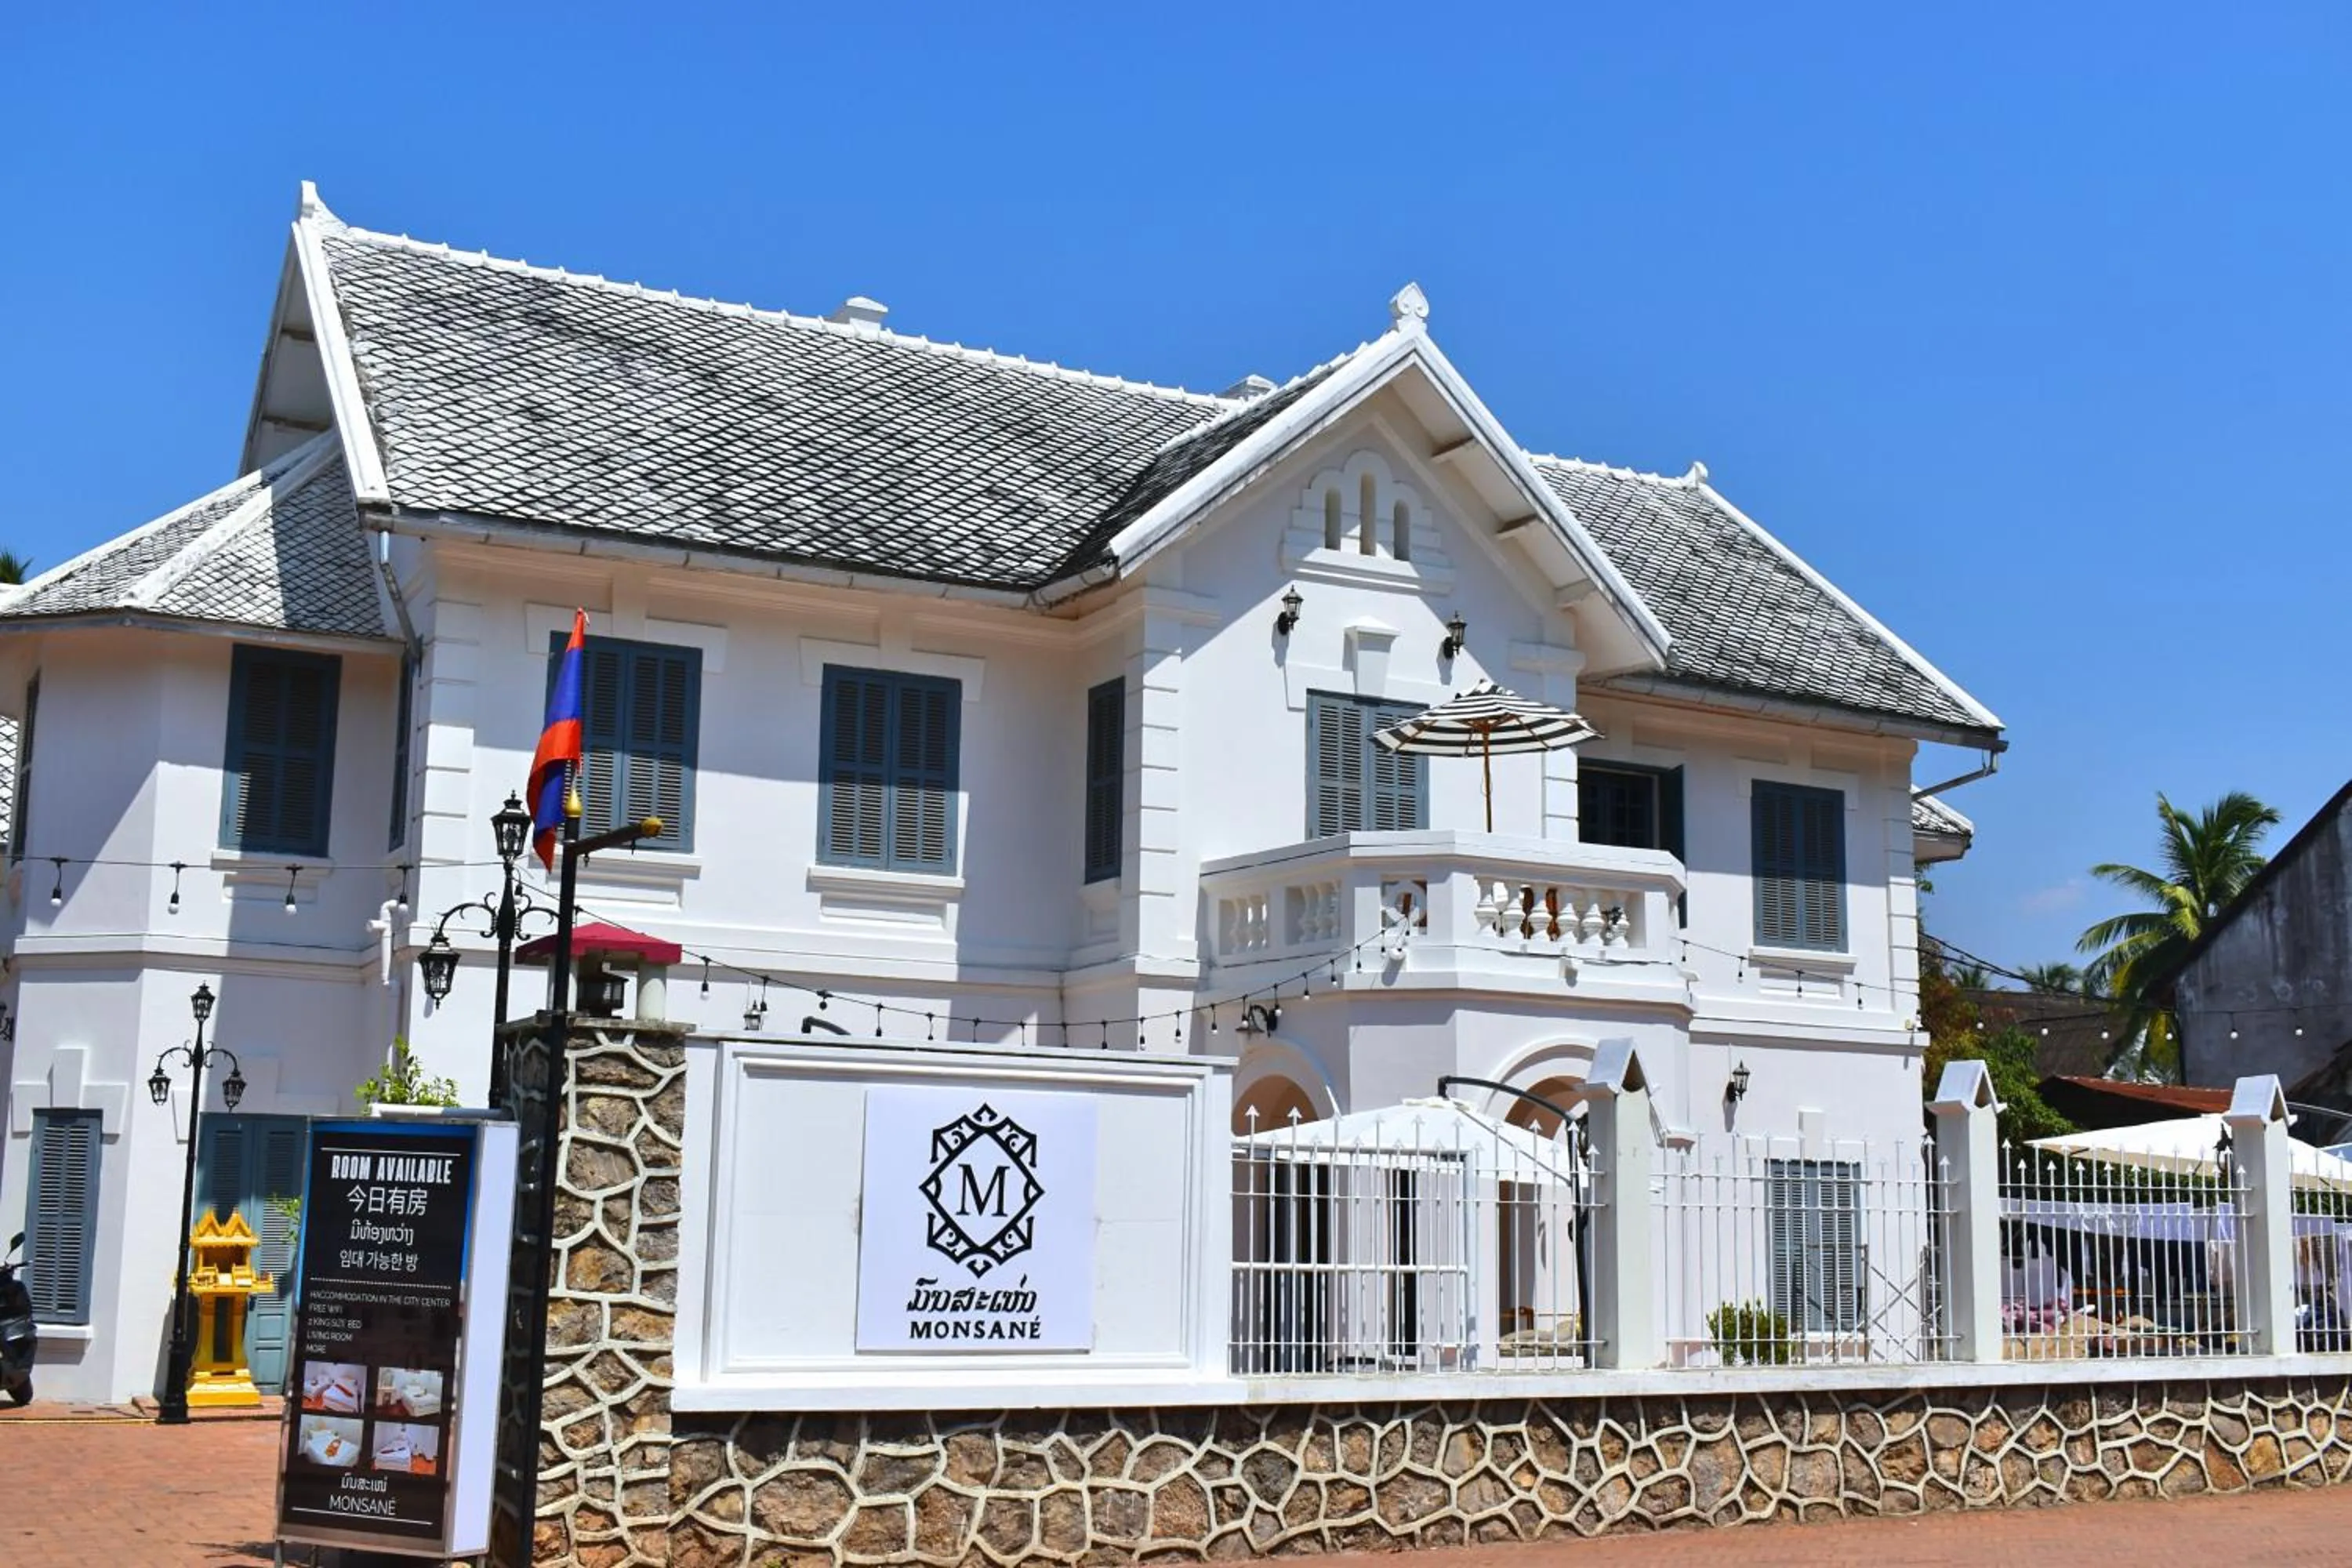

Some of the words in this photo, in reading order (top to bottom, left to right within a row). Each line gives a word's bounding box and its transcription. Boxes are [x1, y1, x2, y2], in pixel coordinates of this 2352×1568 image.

[331, 1155, 371, 1180] ROOM
[376, 1156, 452, 1184] AVAILABLE
[346, 1184, 428, 1216] 今日有房
[956, 1163, 1011, 1217] M
[339, 1250, 364, 1268] 임대
[366, 1250, 402, 1271] 가능한
[405, 1254, 419, 1272] 방
[309, 1303, 326, 1312] FREE
[404, 1296, 419, 1305] CITY
[421, 1298, 451, 1308] CENTER
[314, 1317, 331, 1327] KING
[347, 1319, 362, 1329] BED
[909, 1315, 1041, 1339] MONSANÉ
[307, 1330, 329, 1340] LIVING
[331, 1332, 353, 1341] ROOM
[328, 1494, 397, 1515] MONSANÉ
